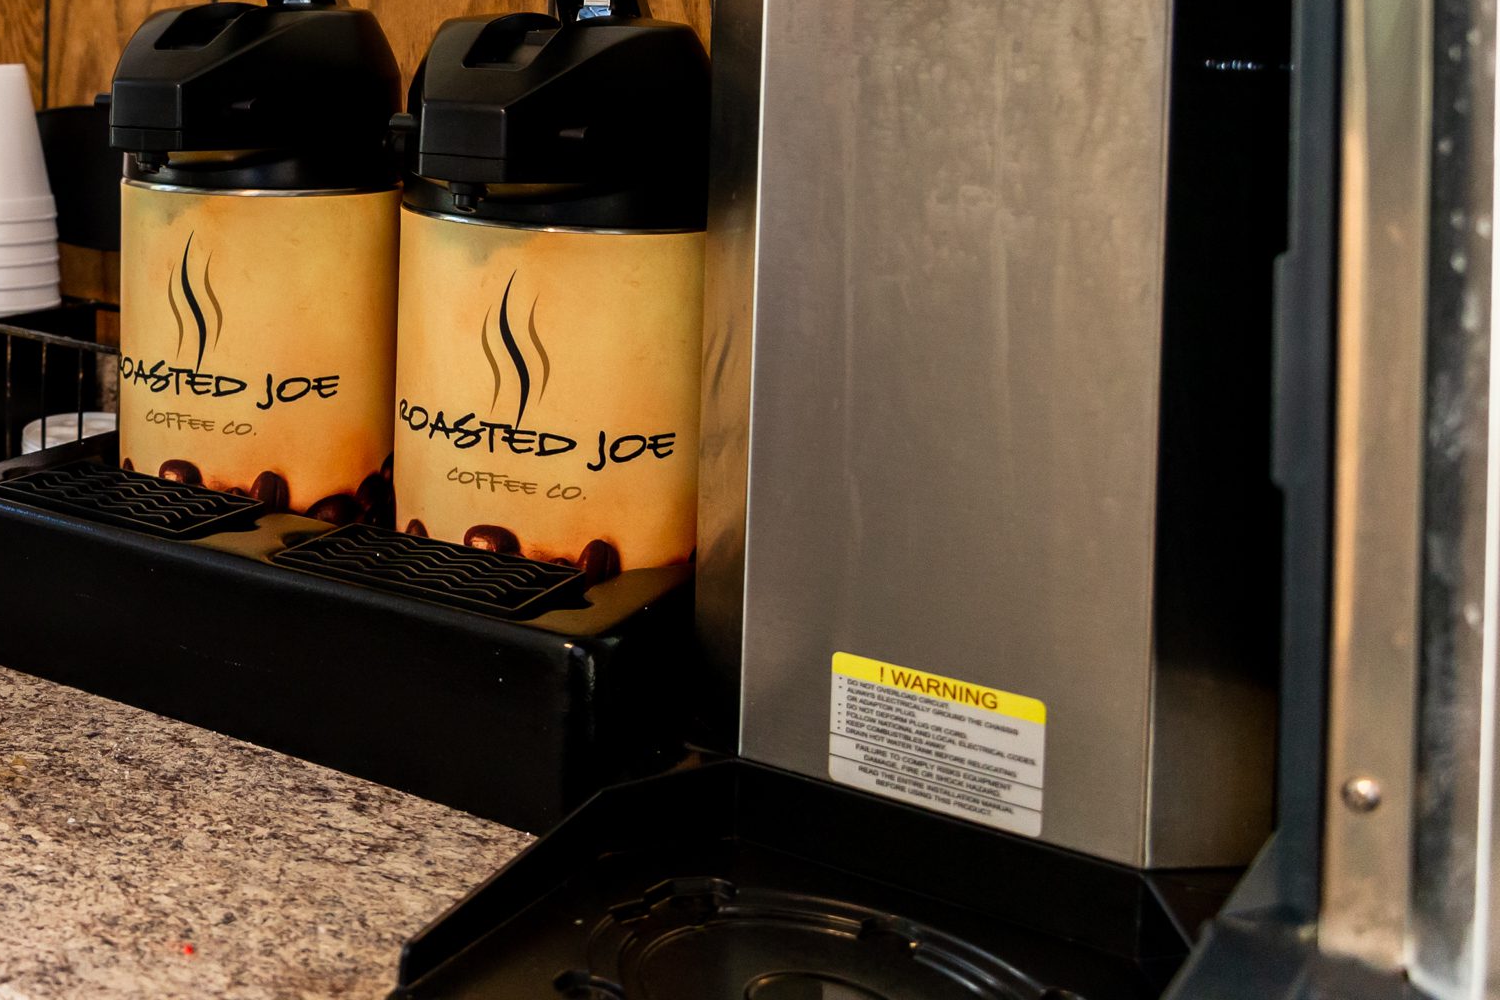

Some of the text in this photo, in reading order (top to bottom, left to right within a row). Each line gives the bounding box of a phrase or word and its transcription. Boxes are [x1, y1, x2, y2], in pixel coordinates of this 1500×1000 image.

[119, 352, 340, 411] OASTED JOE
[145, 408, 257, 436] COFFEE CO.
[399, 399, 676, 472] ROASTED JOE
[446, 467, 587, 501] COFFEE CO.
[891, 669, 998, 710] WARNING
